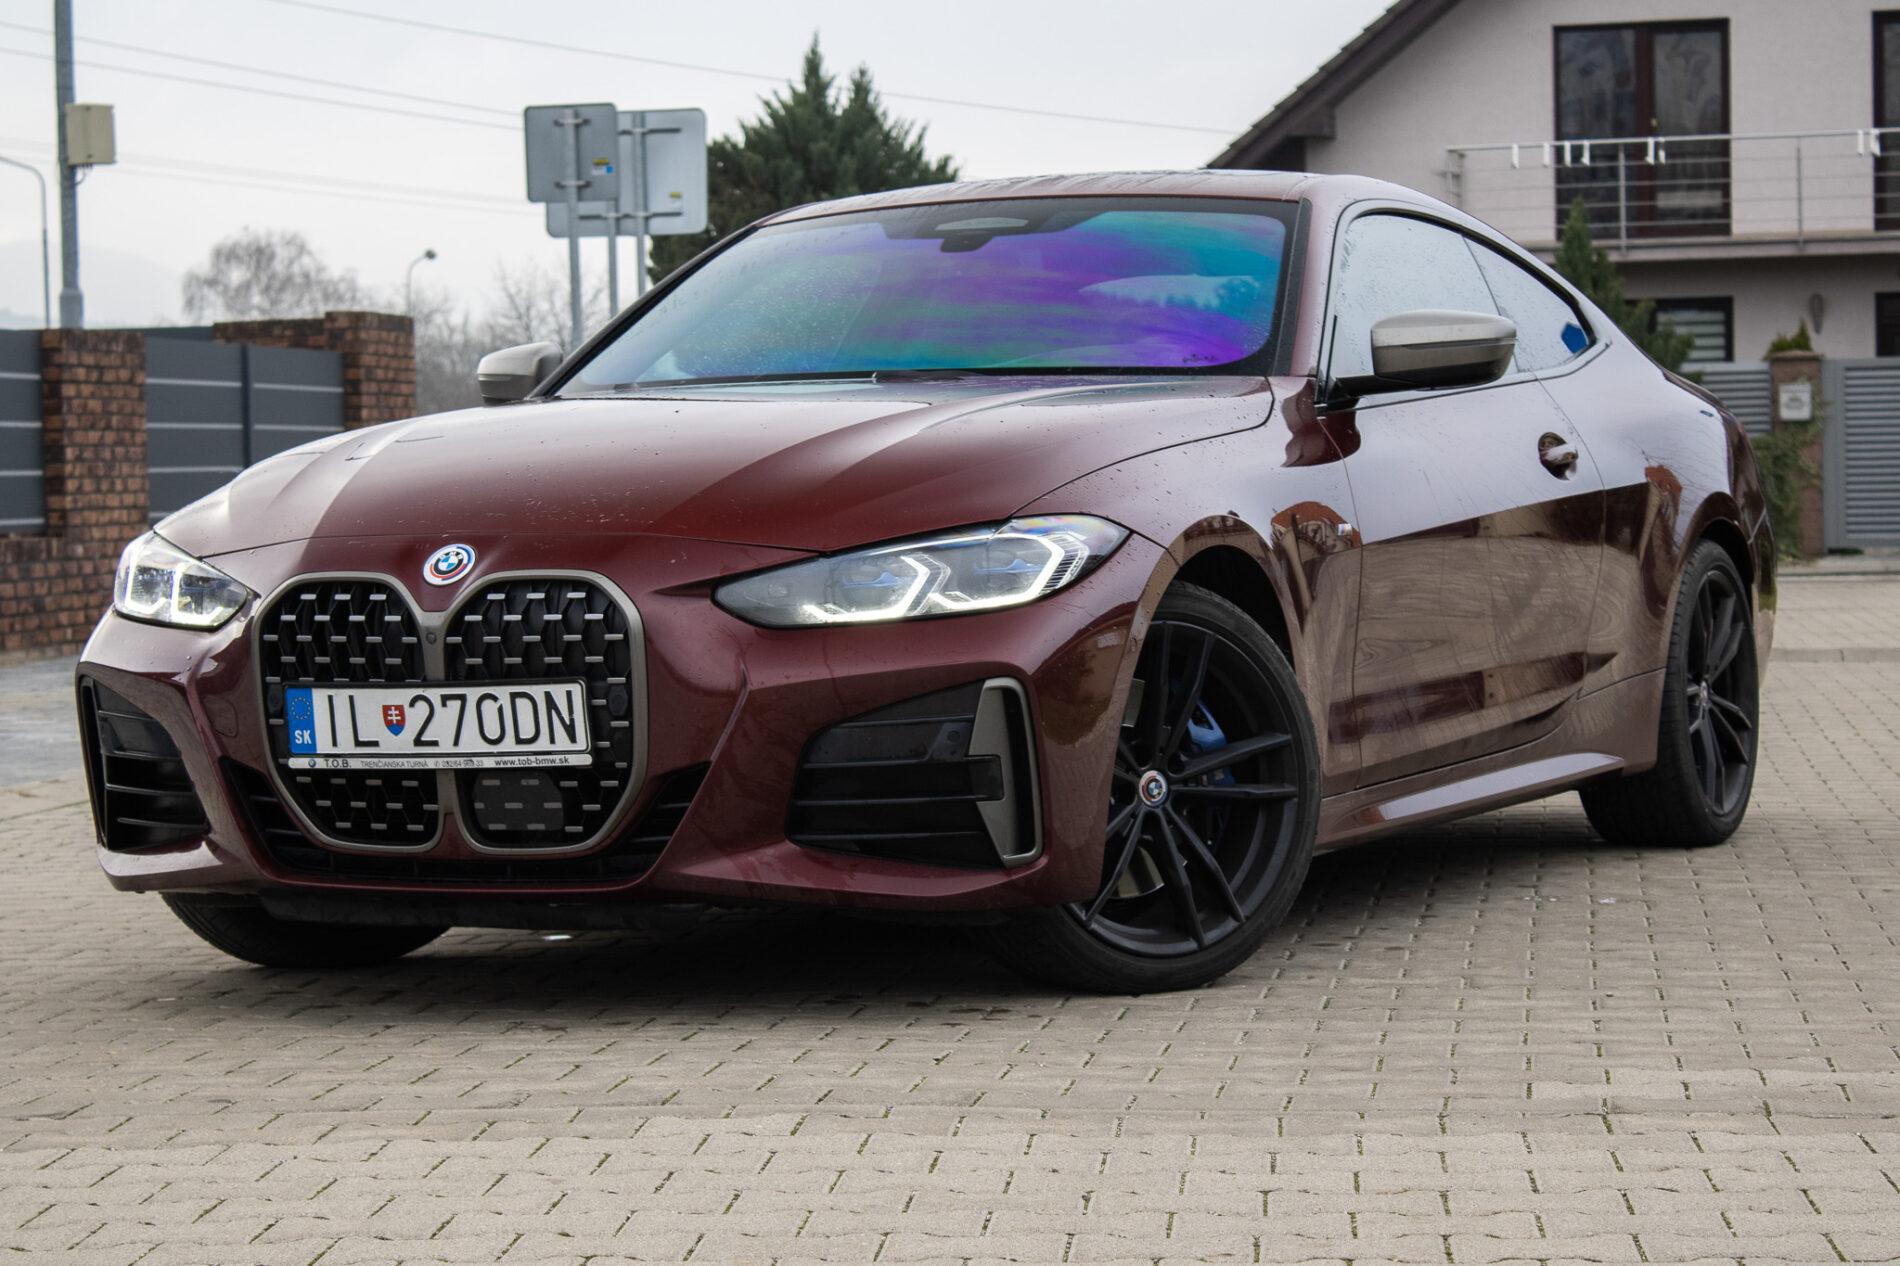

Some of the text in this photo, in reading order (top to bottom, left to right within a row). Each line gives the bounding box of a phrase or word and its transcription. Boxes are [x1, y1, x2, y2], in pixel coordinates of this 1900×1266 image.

[327, 689, 578, 748] IL 270DN
[294, 729, 312, 745] SK
[494, 756, 569, 767] www.tob-bmw.sk
